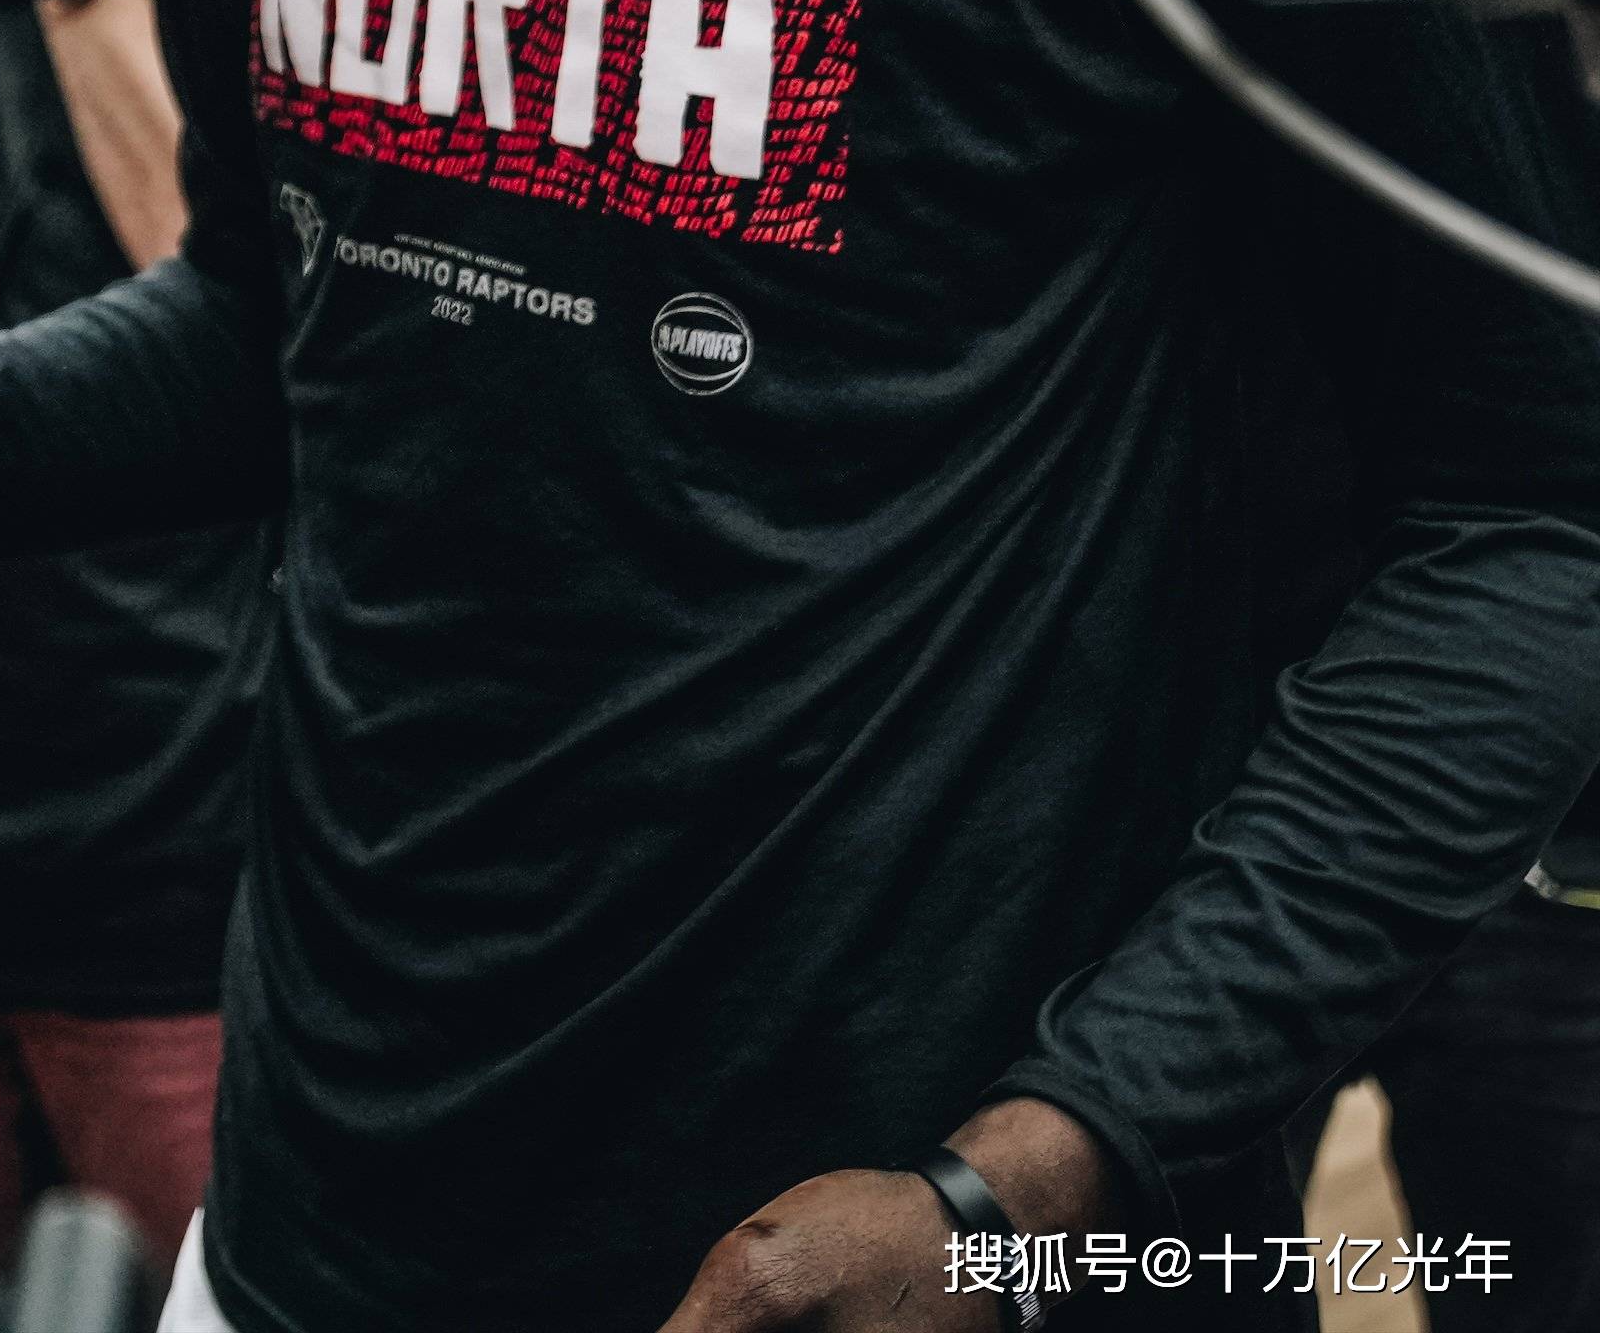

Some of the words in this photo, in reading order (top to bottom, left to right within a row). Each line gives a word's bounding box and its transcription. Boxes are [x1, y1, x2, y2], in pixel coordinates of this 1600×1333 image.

[431, 294, 475, 326] 2022
[456, 267, 598, 327] RAPTORS
[669, 326, 744, 363] PLAYOFFS
